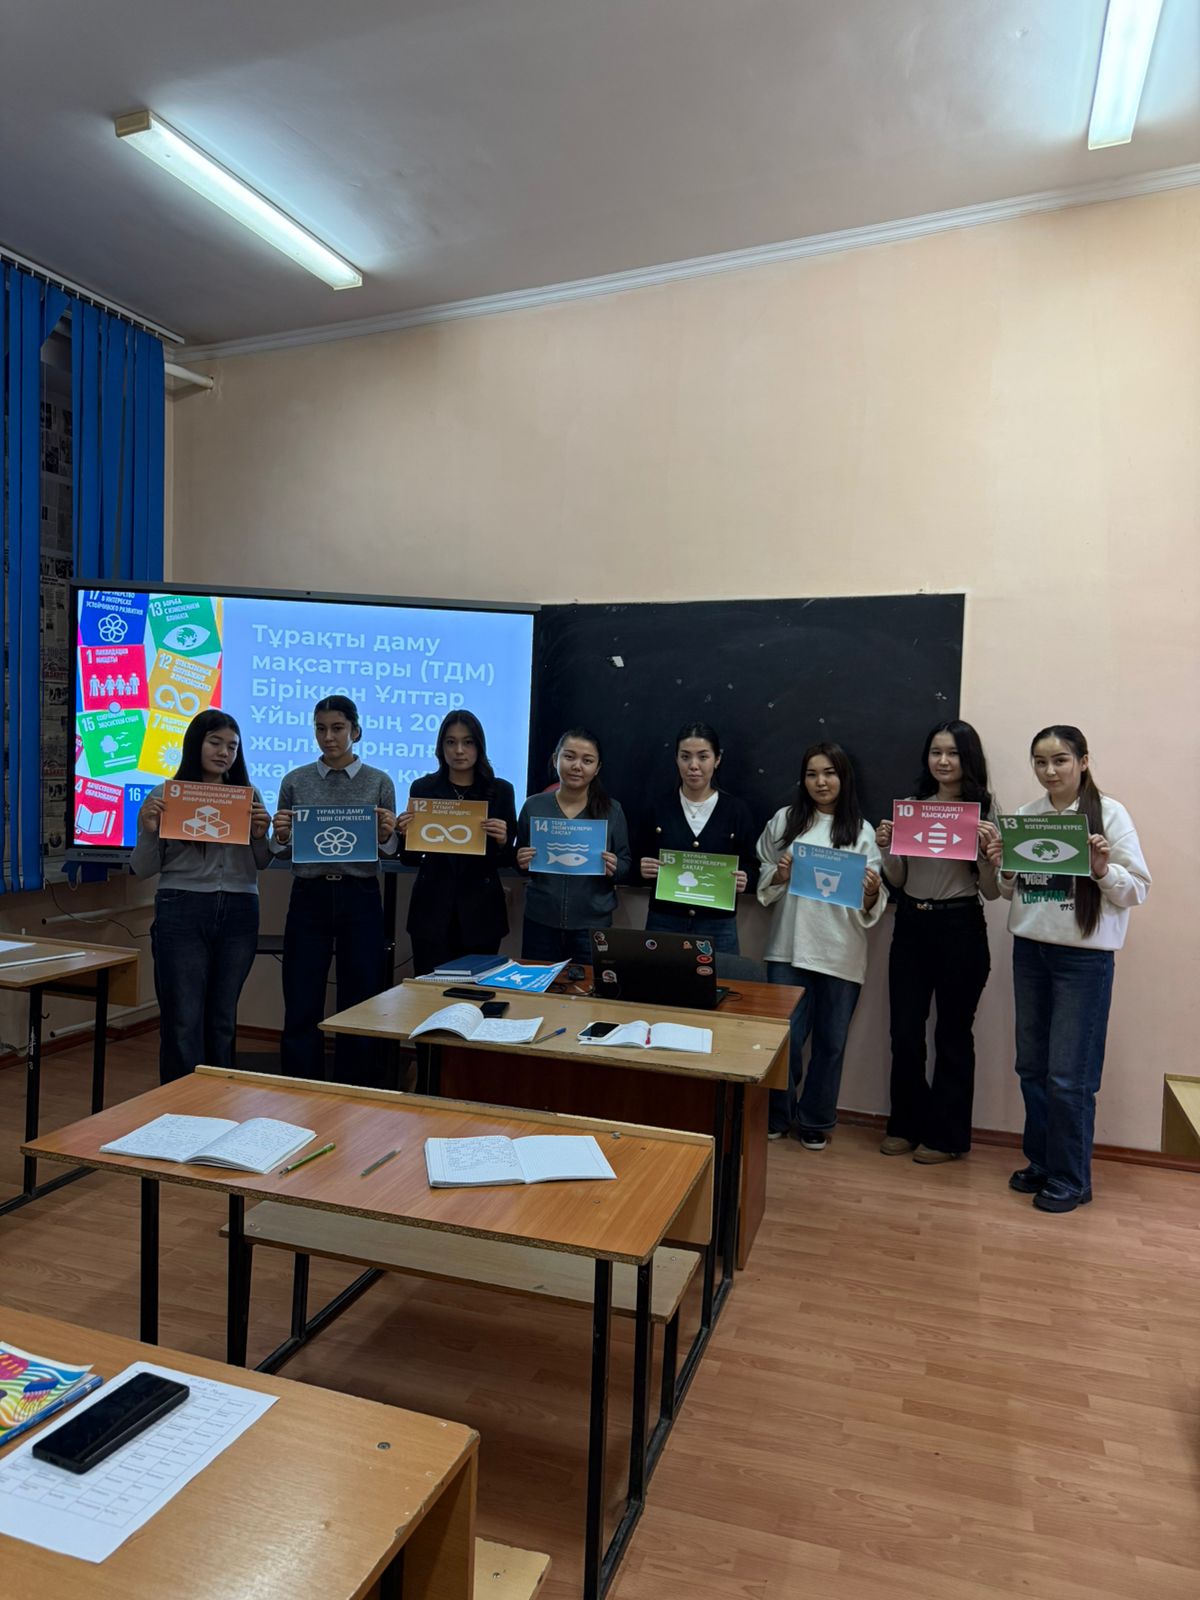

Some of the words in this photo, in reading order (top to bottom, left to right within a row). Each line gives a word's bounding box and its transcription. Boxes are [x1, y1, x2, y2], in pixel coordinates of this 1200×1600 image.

[149, 601, 162, 617] 13
[252, 624, 366, 648] Тұрақты
[373, 634, 441, 656] даму
[86, 648, 93, 664] 1
[252, 655, 411, 680] мақсаттары
[420, 659, 495, 686] (ТДМ)
[375, 684, 465, 708] Ұлттар
[82, 716, 95, 731] 15
[128, 787, 141, 802] 16
[170, 784, 181, 797] 9
[413, 800, 428, 812] 12
[897, 804, 914, 817] 10
[296, 809, 310, 822] 17
[534, 820, 548, 832] 14
[1001, 817, 1018, 829] 13
[798, 845, 807, 858] 6
[662, 853, 676, 864] 15
